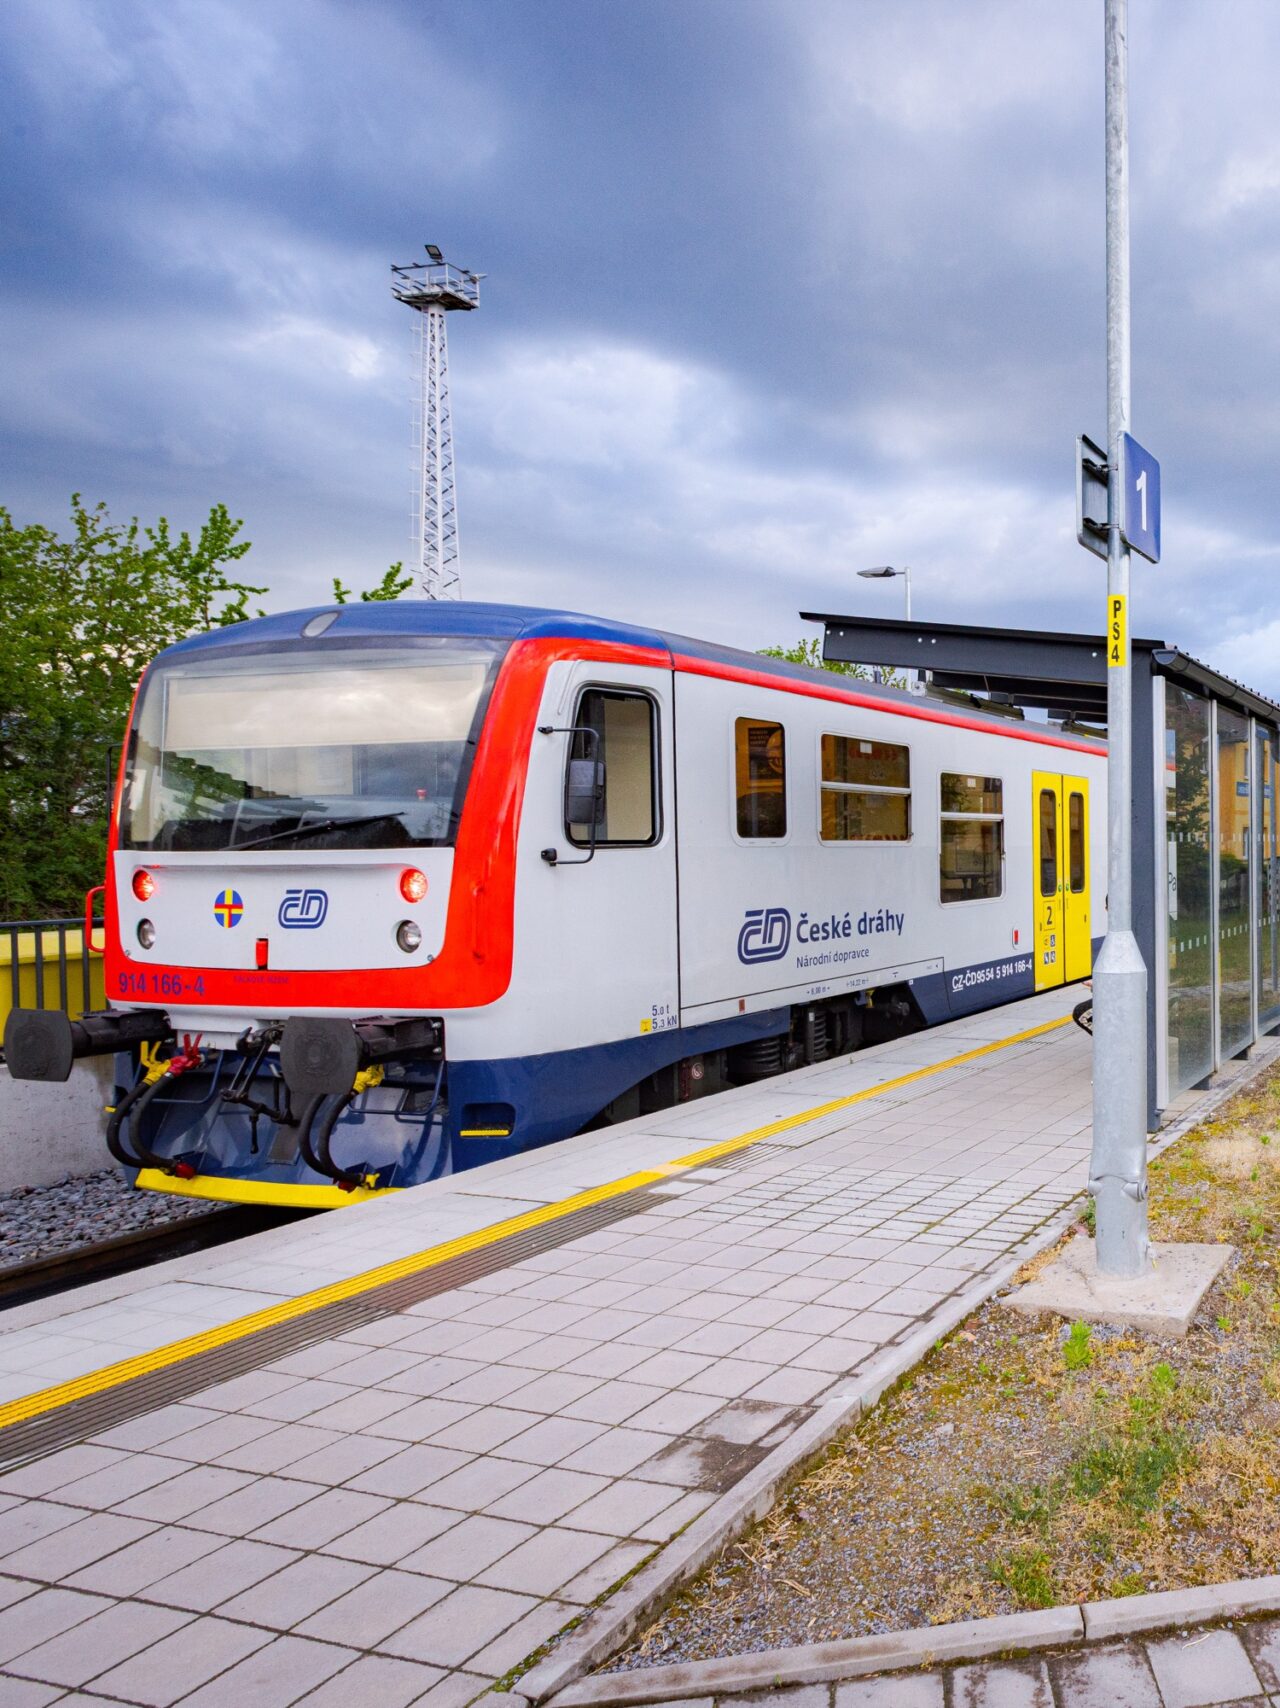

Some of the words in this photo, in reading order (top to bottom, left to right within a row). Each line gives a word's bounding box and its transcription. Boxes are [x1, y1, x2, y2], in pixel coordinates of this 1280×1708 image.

[1136, 470, 1147, 532] 1
[796, 912, 852, 943] České
[857, 909, 905, 936] dráhy
[1046, 905, 1053, 926] 2
[796, 951, 832, 968] Národní
[833, 948, 870, 964] dopravce
[996, 966, 1001, 979] 5
[1002, 963, 1013, 977] 914
[1014, 959, 1033, 973] 166-4
[118, 972, 146, 993] 914
[667, 1015, 677, 1026] kN
